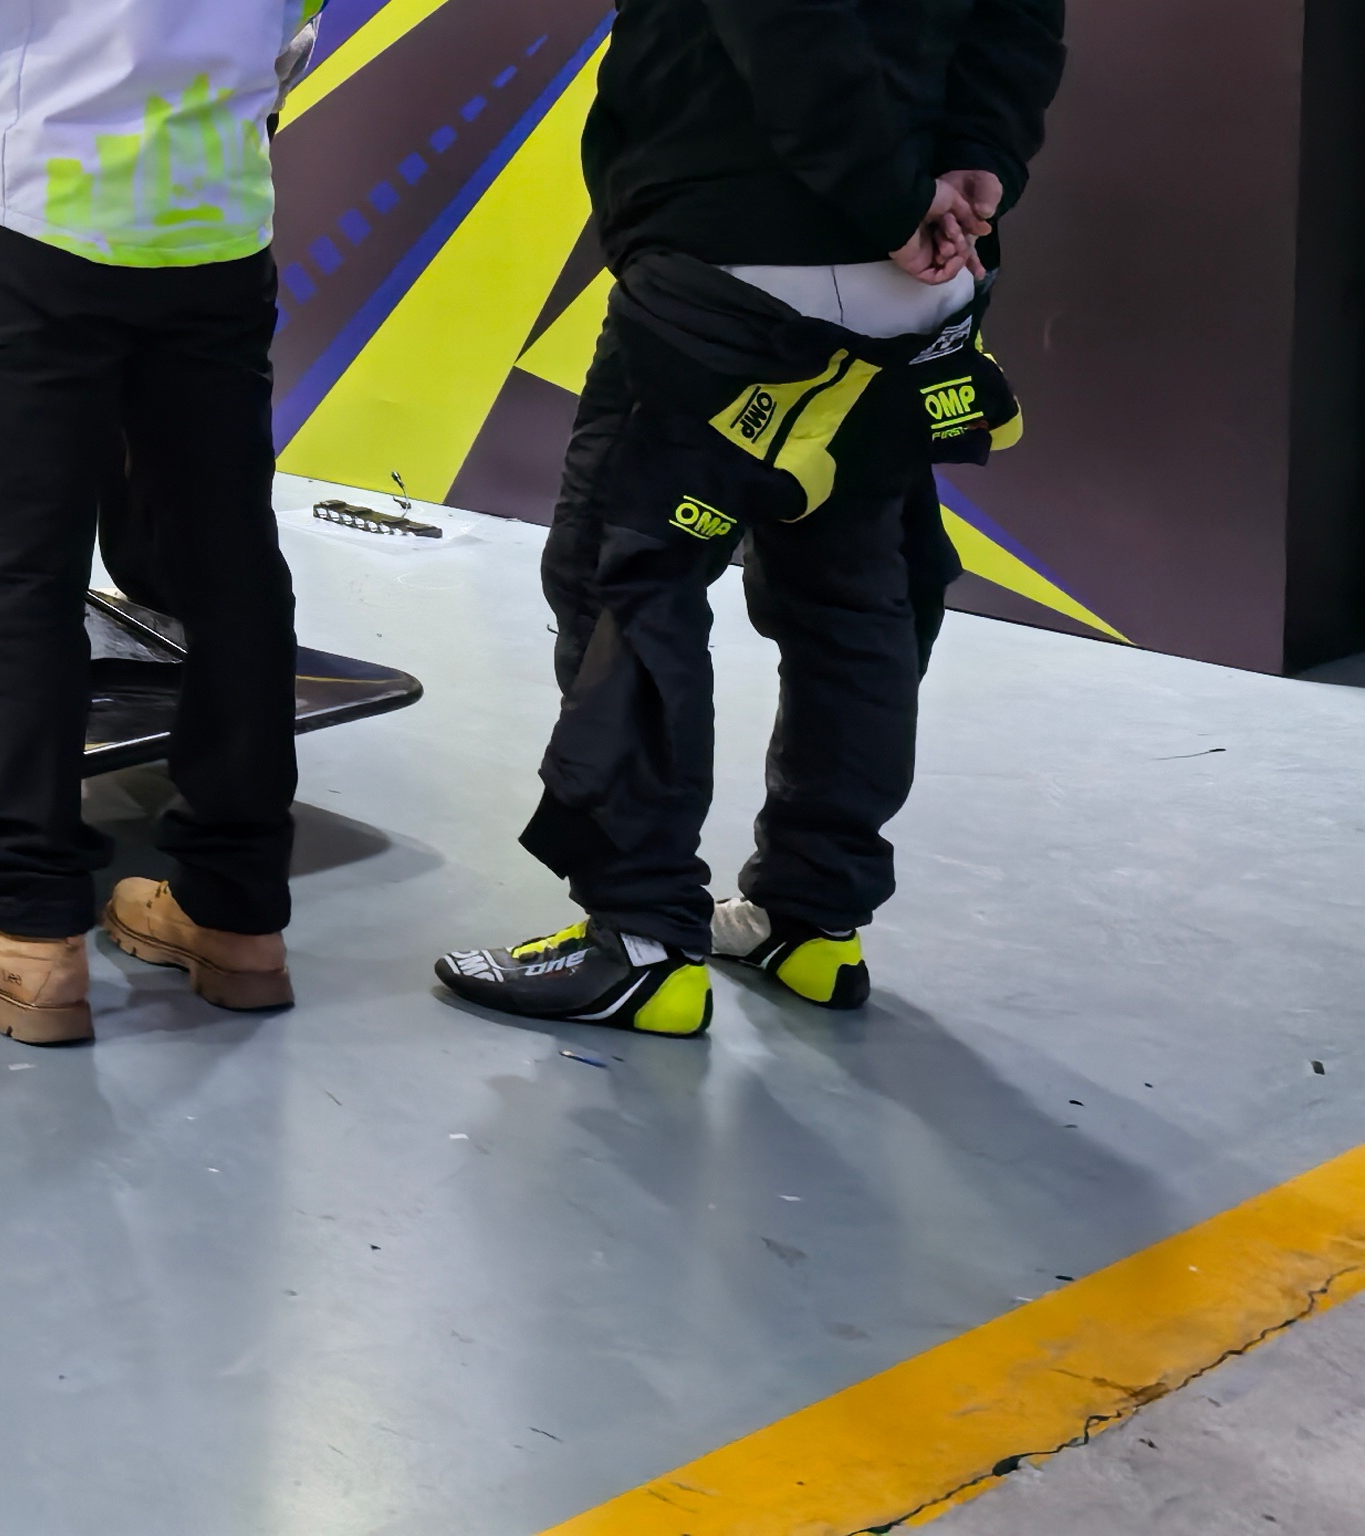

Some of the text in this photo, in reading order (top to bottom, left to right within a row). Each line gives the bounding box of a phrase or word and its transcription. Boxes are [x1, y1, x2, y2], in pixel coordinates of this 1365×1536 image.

[739, 391, 773, 439] OMP
[924, 385, 976, 420] OMP
[675, 502, 731, 537] OMP
